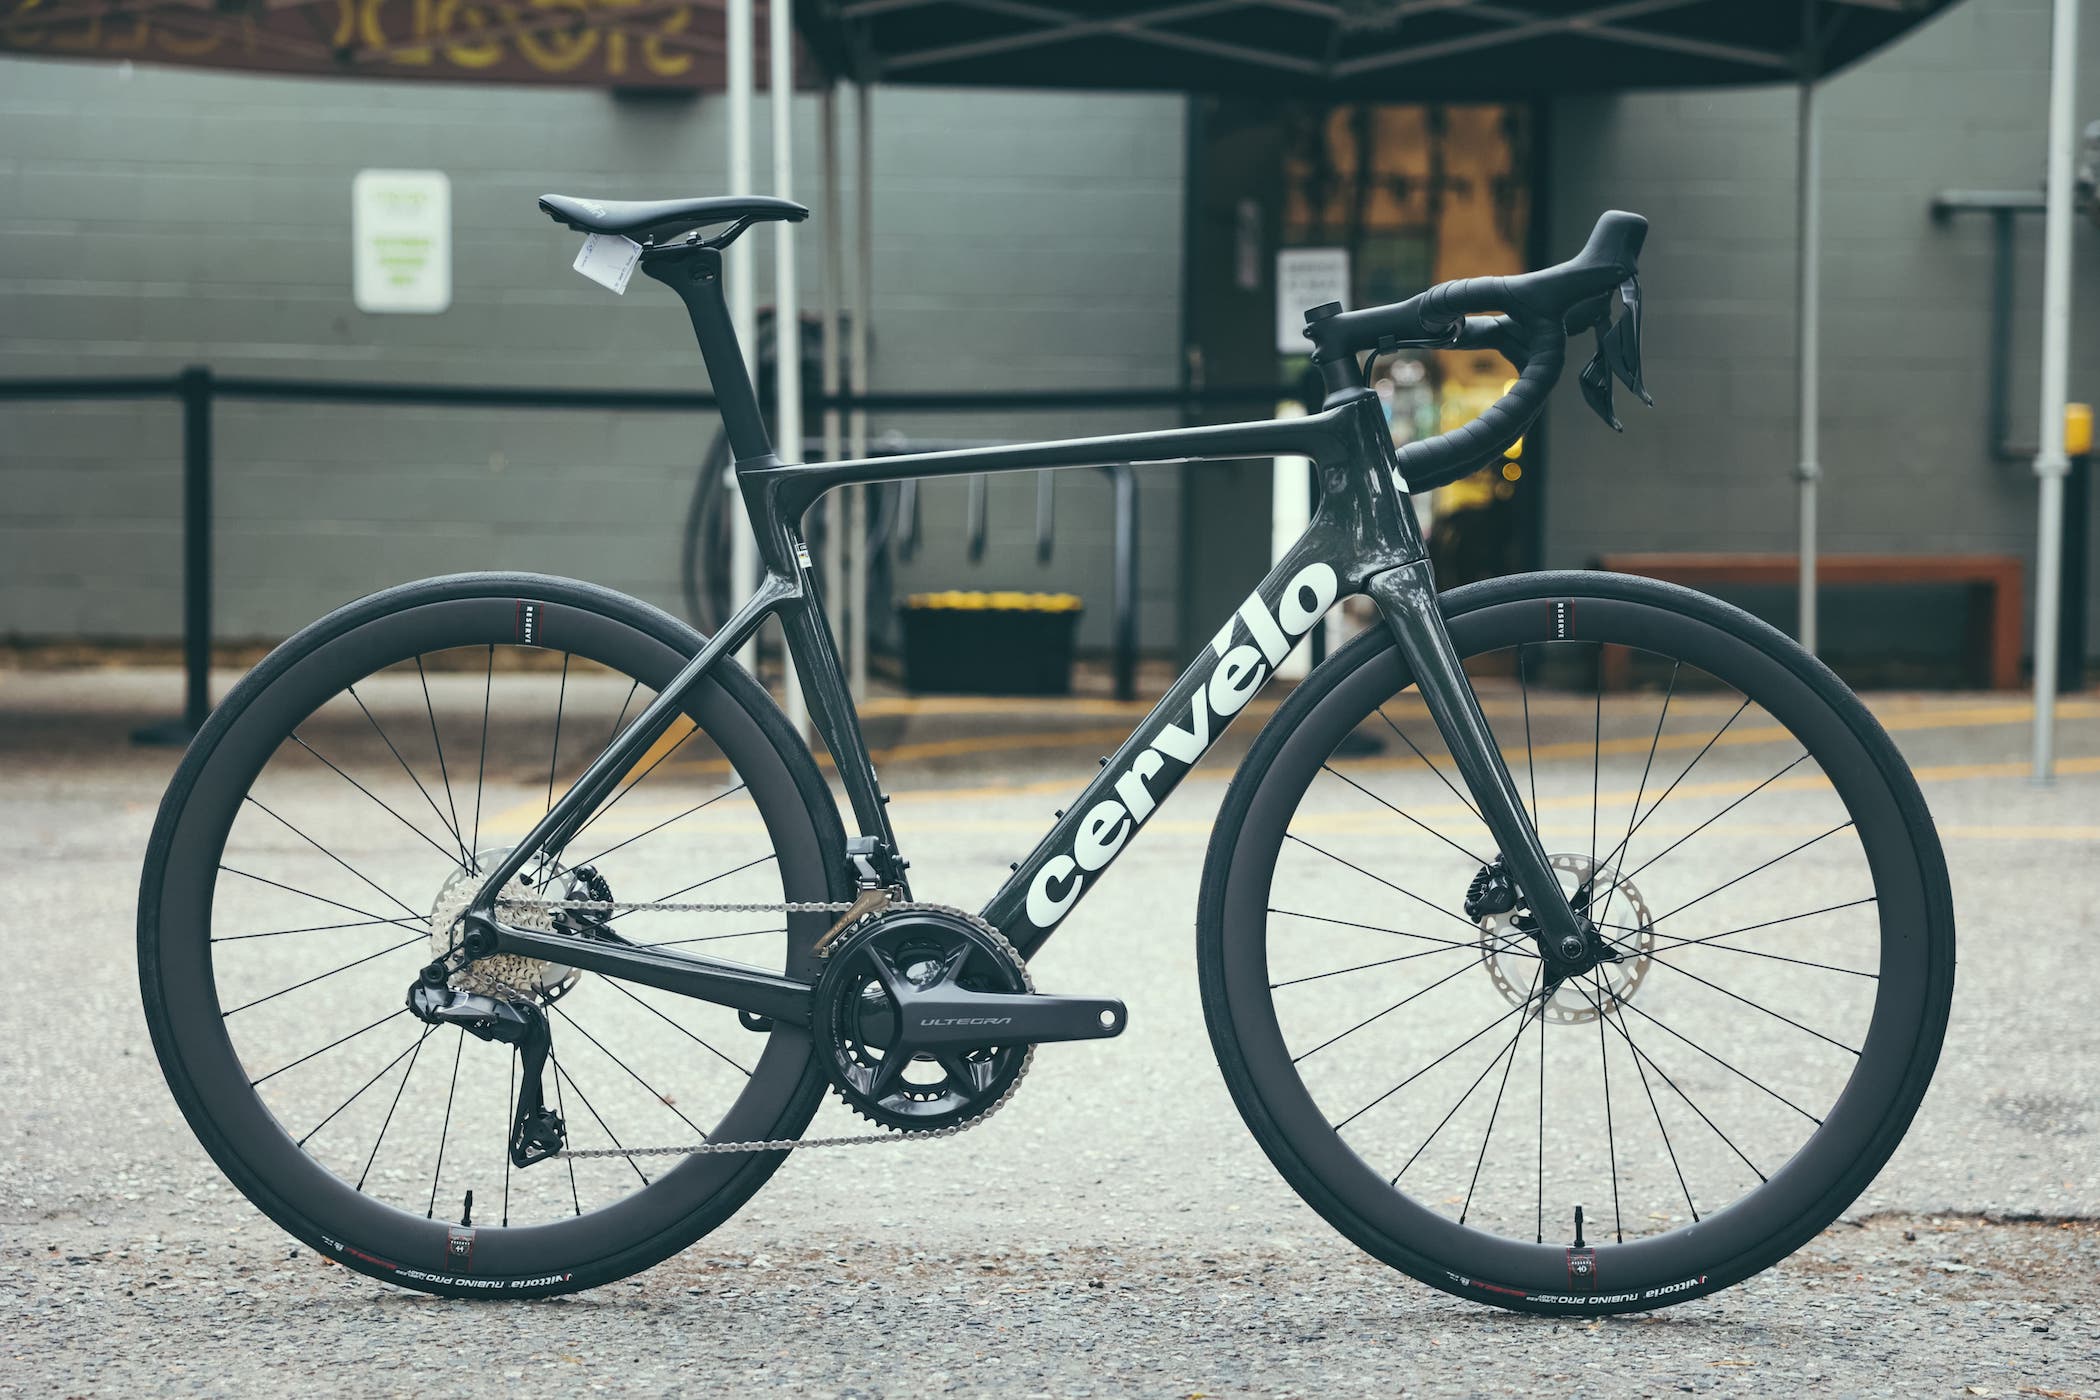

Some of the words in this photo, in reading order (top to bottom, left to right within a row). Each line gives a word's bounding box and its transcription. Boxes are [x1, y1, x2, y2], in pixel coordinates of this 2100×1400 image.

[1025, 562, 1338, 928] cervélo
[920, 1017, 1012, 1026] ULTEGRA
[426, 1274, 453, 1285] PRO
[455, 1278, 504, 1289] RUBINO
[1558, 1296, 1586, 1304] PRO
[1588, 1293, 1639, 1305] RUBINO
